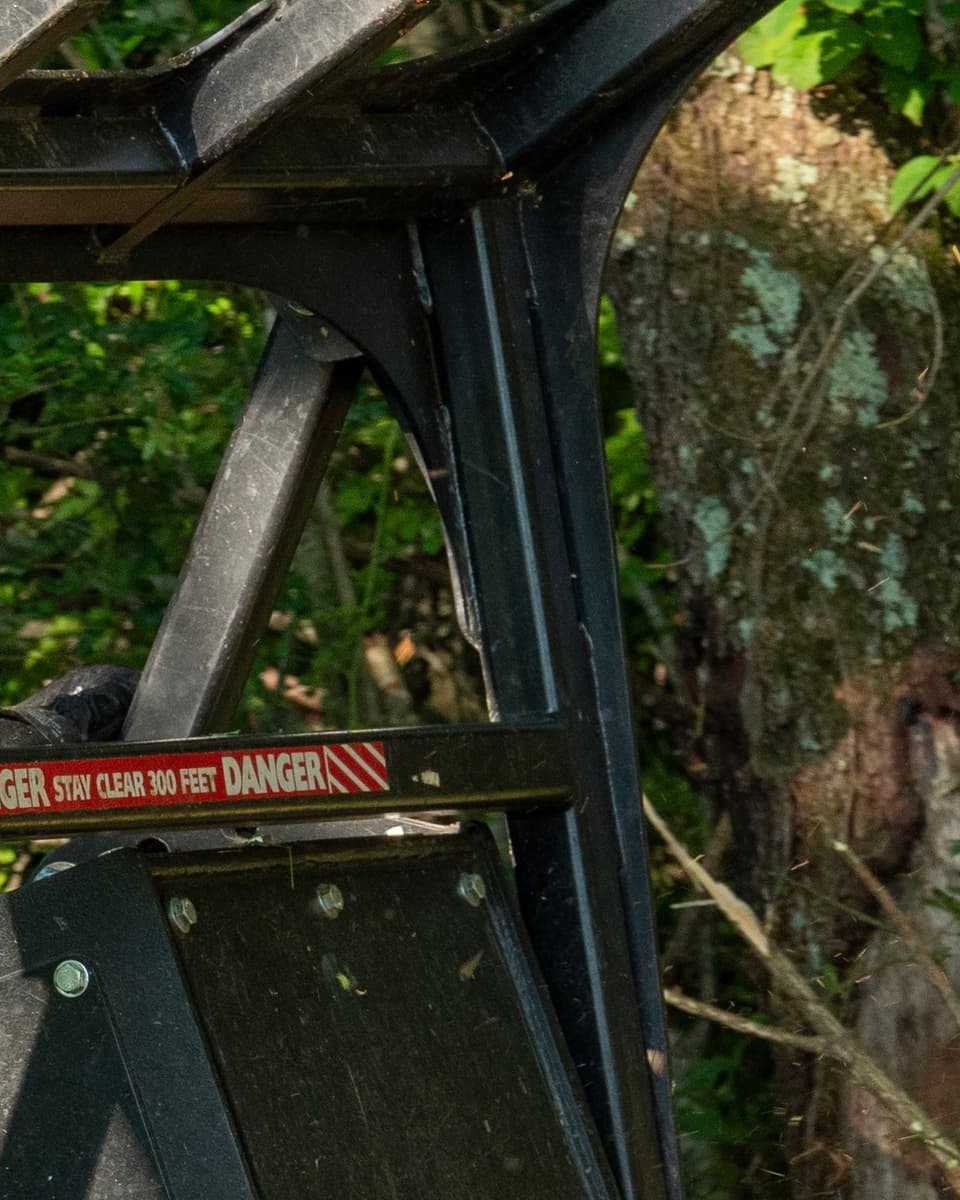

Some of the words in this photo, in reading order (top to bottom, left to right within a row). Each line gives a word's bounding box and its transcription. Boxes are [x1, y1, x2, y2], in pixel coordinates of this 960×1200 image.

[52, 774, 92, 802] STAY
[96, 771, 146, 799] CLEAR
[148, 769, 177, 796] 300
[180, 766, 217, 794] FEET
[221, 751, 327, 796] DANGER
